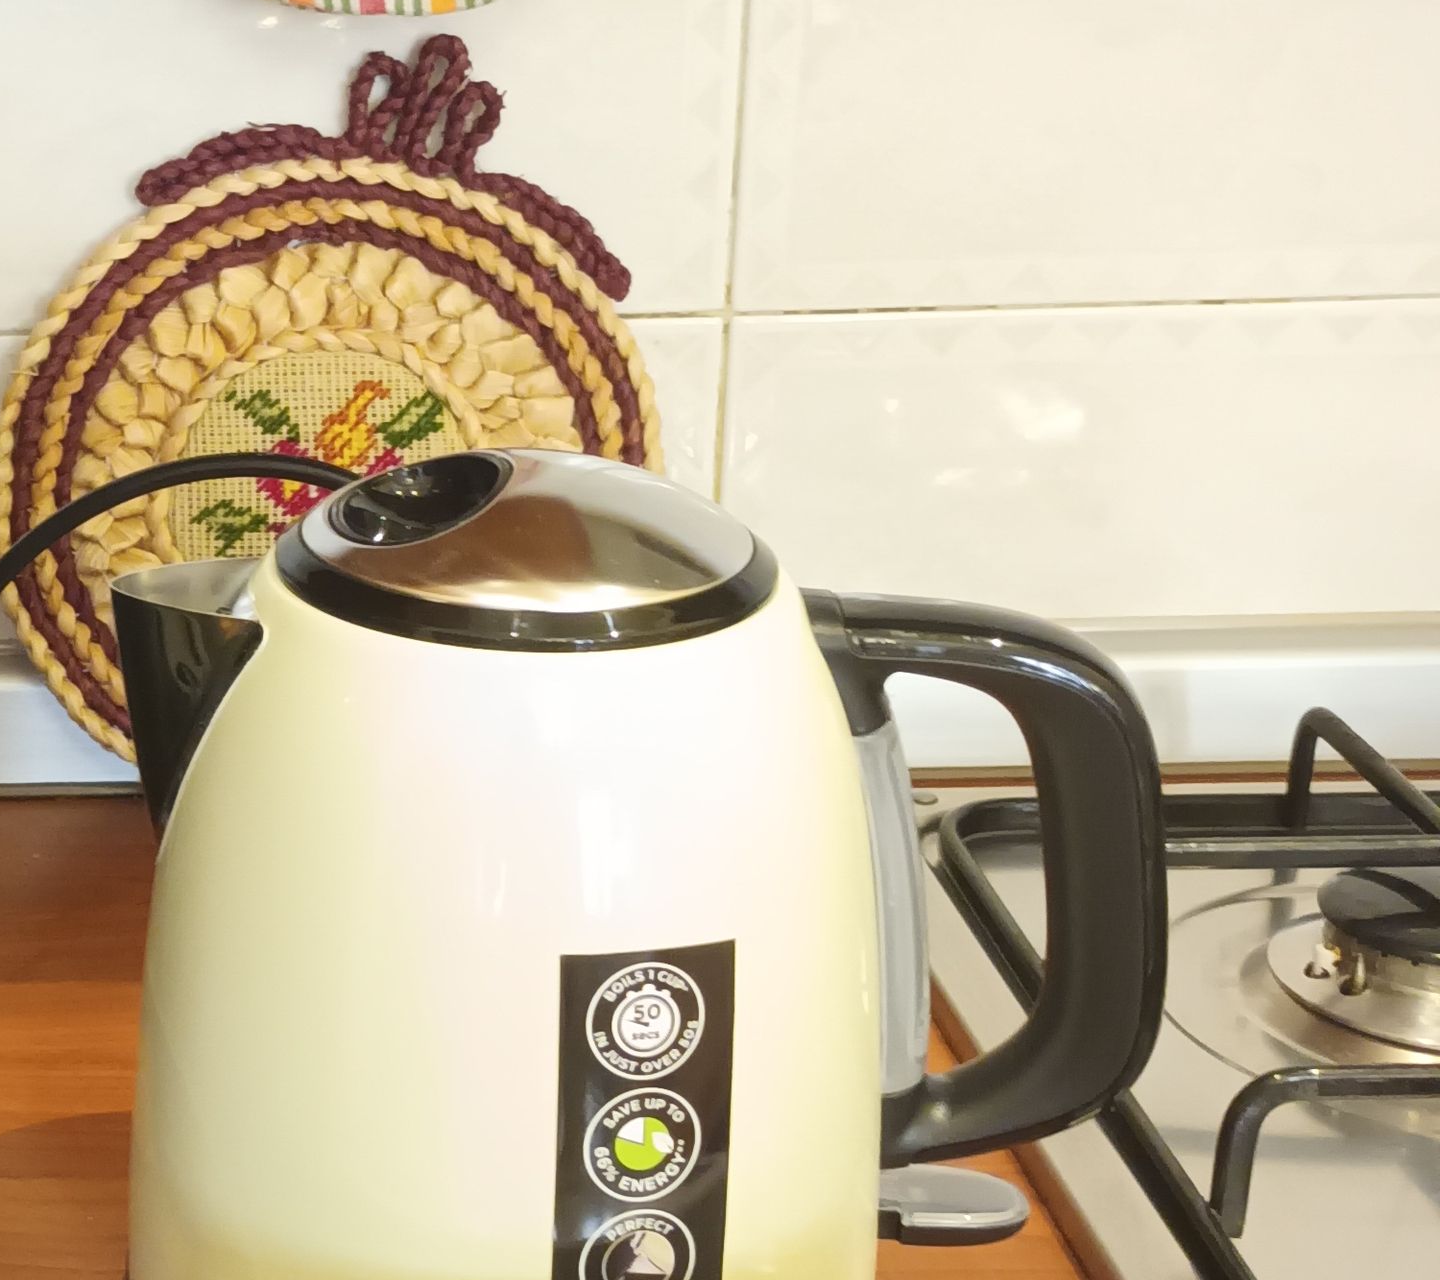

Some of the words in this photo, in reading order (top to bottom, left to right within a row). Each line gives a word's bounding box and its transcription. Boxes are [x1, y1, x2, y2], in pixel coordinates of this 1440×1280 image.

[602, 969, 646, 1003] BOILS
[633, 1003, 661, 1021] 50
[602, 1049, 640, 1072] JUST
[640, 1048, 682, 1073] OVER
[602, 1098, 642, 1129] SAVE
[644, 1098, 667, 1110] UP
[666, 1103, 686, 1123] TO
[605, 1217, 674, 1242] PERFECT
